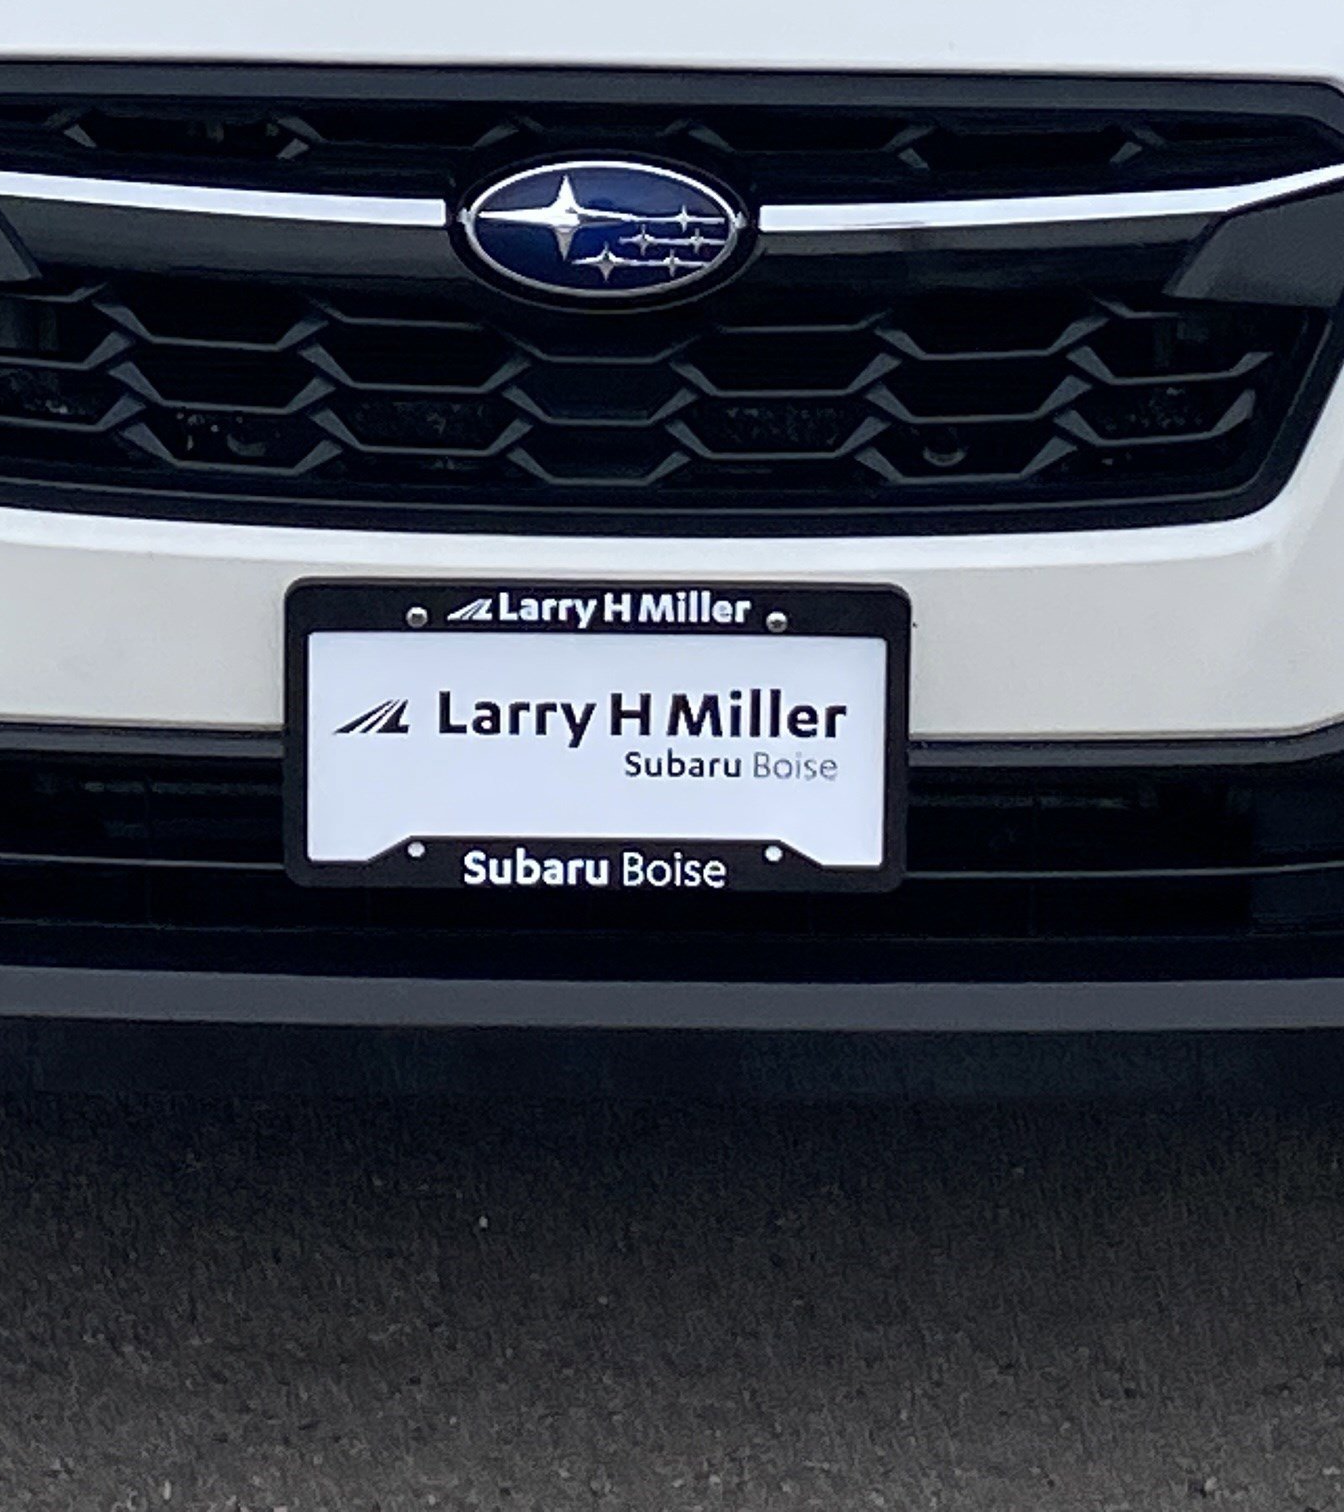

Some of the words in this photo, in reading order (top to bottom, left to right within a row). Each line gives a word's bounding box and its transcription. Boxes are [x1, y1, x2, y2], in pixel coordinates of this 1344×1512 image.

[499, 592, 598, 629] Larry
[603, 592, 632, 622] H
[638, 590, 752, 624] Miller
[438, 690, 597, 749] Larry
[610, 692, 652, 737] H
[666, 688, 847, 739] Miller
[624, 750, 742, 779] Subaru
[752, 751, 839, 781] Boise
[463, 847, 609, 886] Subaru
[623, 850, 727, 888] Boise
